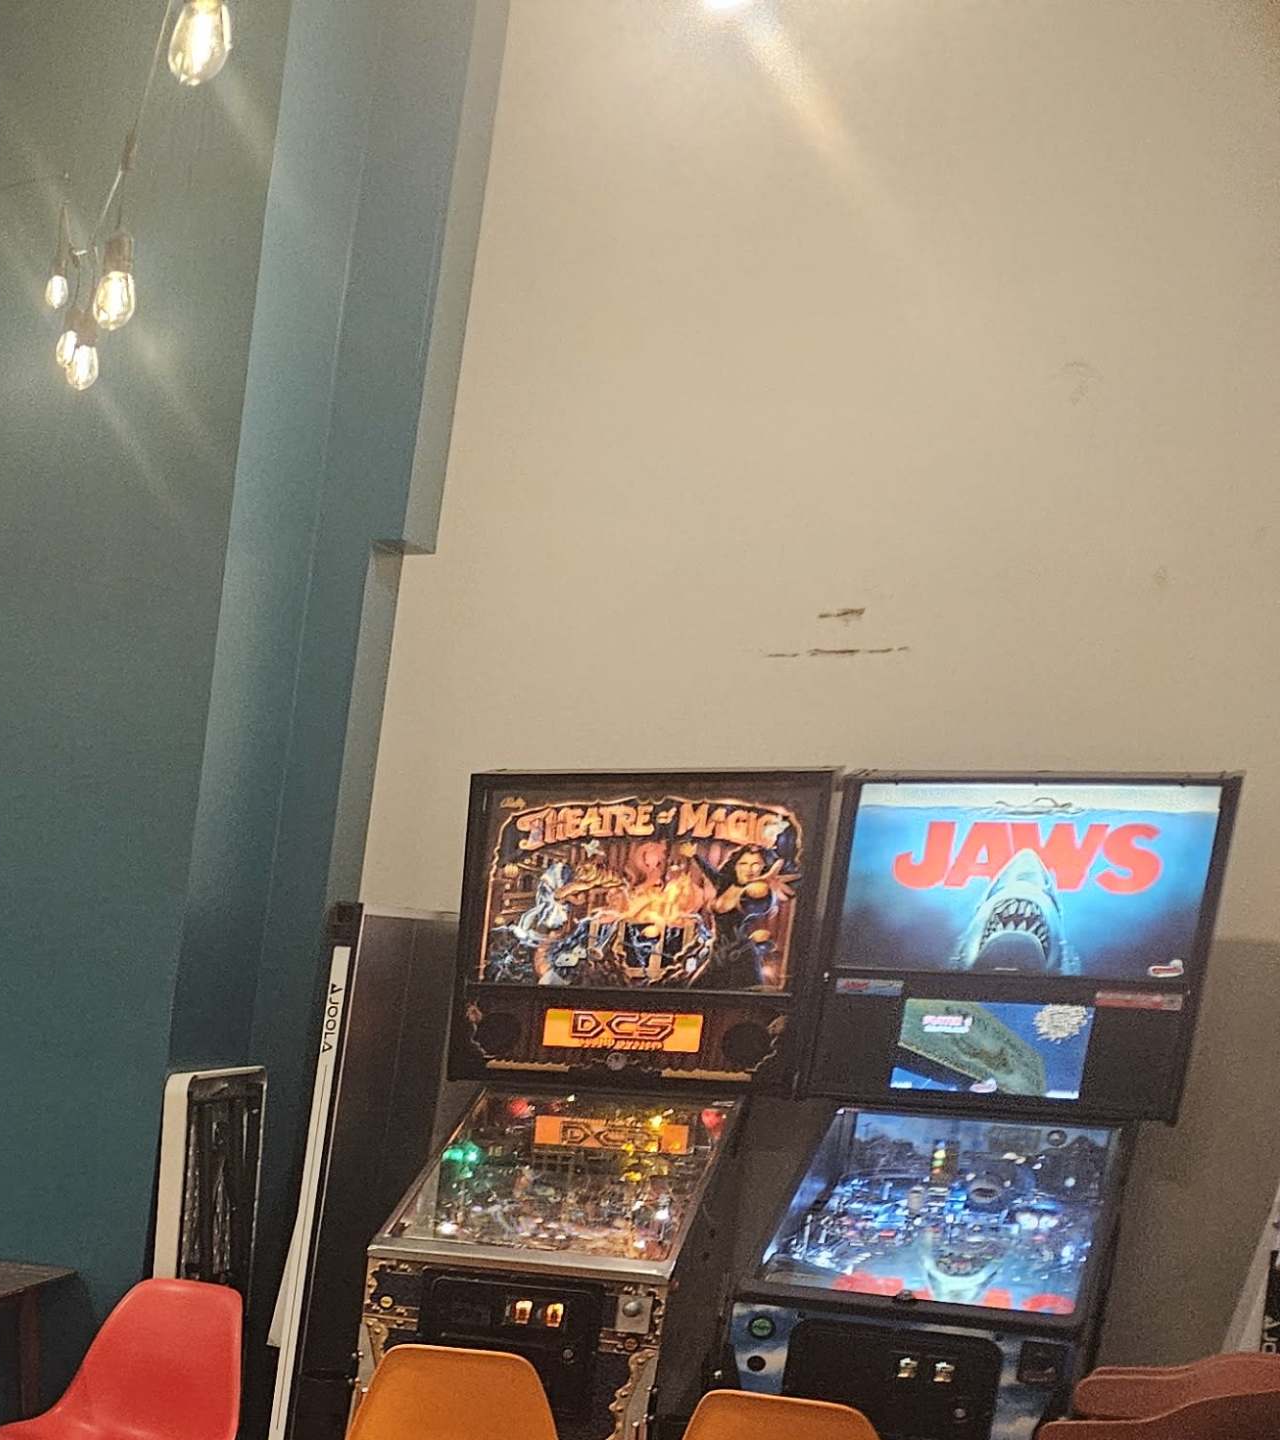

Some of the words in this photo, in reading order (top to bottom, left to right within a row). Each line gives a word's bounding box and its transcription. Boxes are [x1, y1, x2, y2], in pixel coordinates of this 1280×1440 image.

[516, 804, 655, 850] THEATRE
[676, 803, 775, 848] MAGIC
[893, 820, 1162, 894] JAWS
[322, 997, 340, 1052] JOOLA
[571, 1010, 674, 1041] DCS
